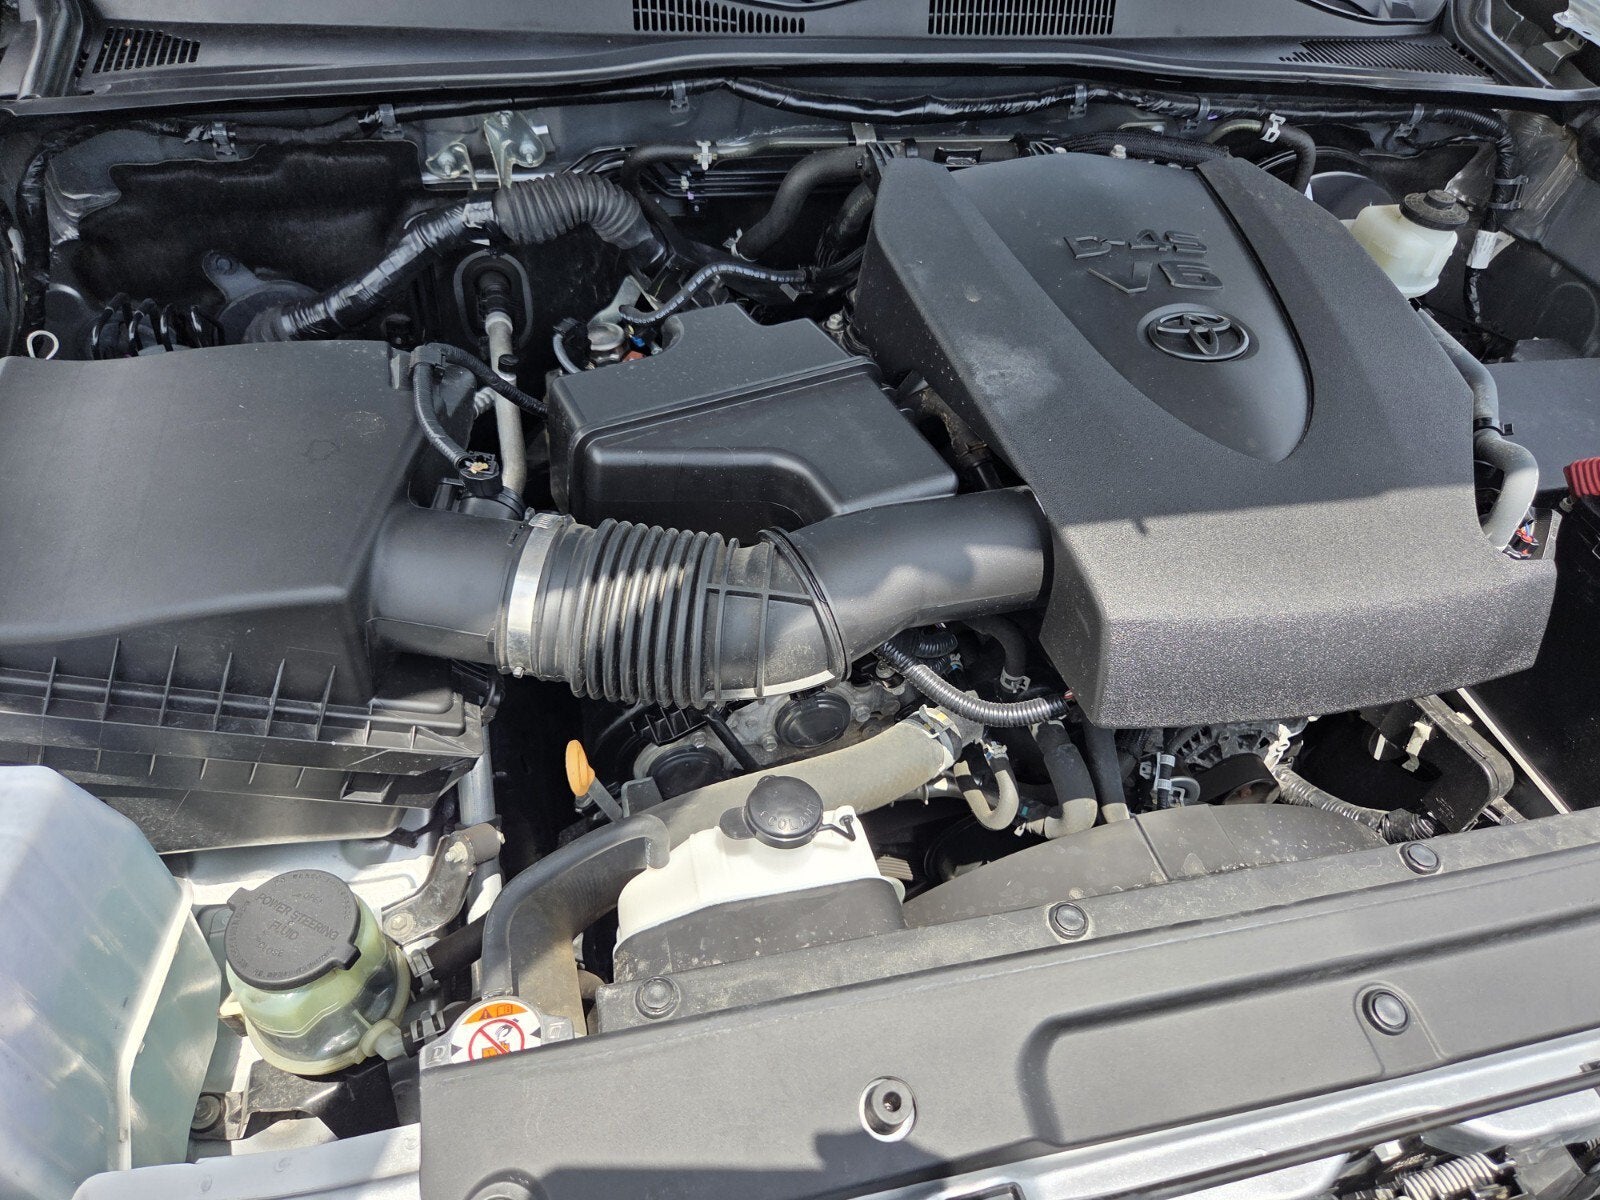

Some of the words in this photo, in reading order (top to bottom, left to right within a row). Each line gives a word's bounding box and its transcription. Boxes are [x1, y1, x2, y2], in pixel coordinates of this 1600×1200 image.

[1064, 229, 1208, 259] D-4S
[1088, 261, 1223, 293] V6
[760, 803, 817, 830] COOLANT
[256, 893, 292, 915] POWER
[291, 911, 339, 940] STEERING
[269, 921, 299, 940] FLUID
